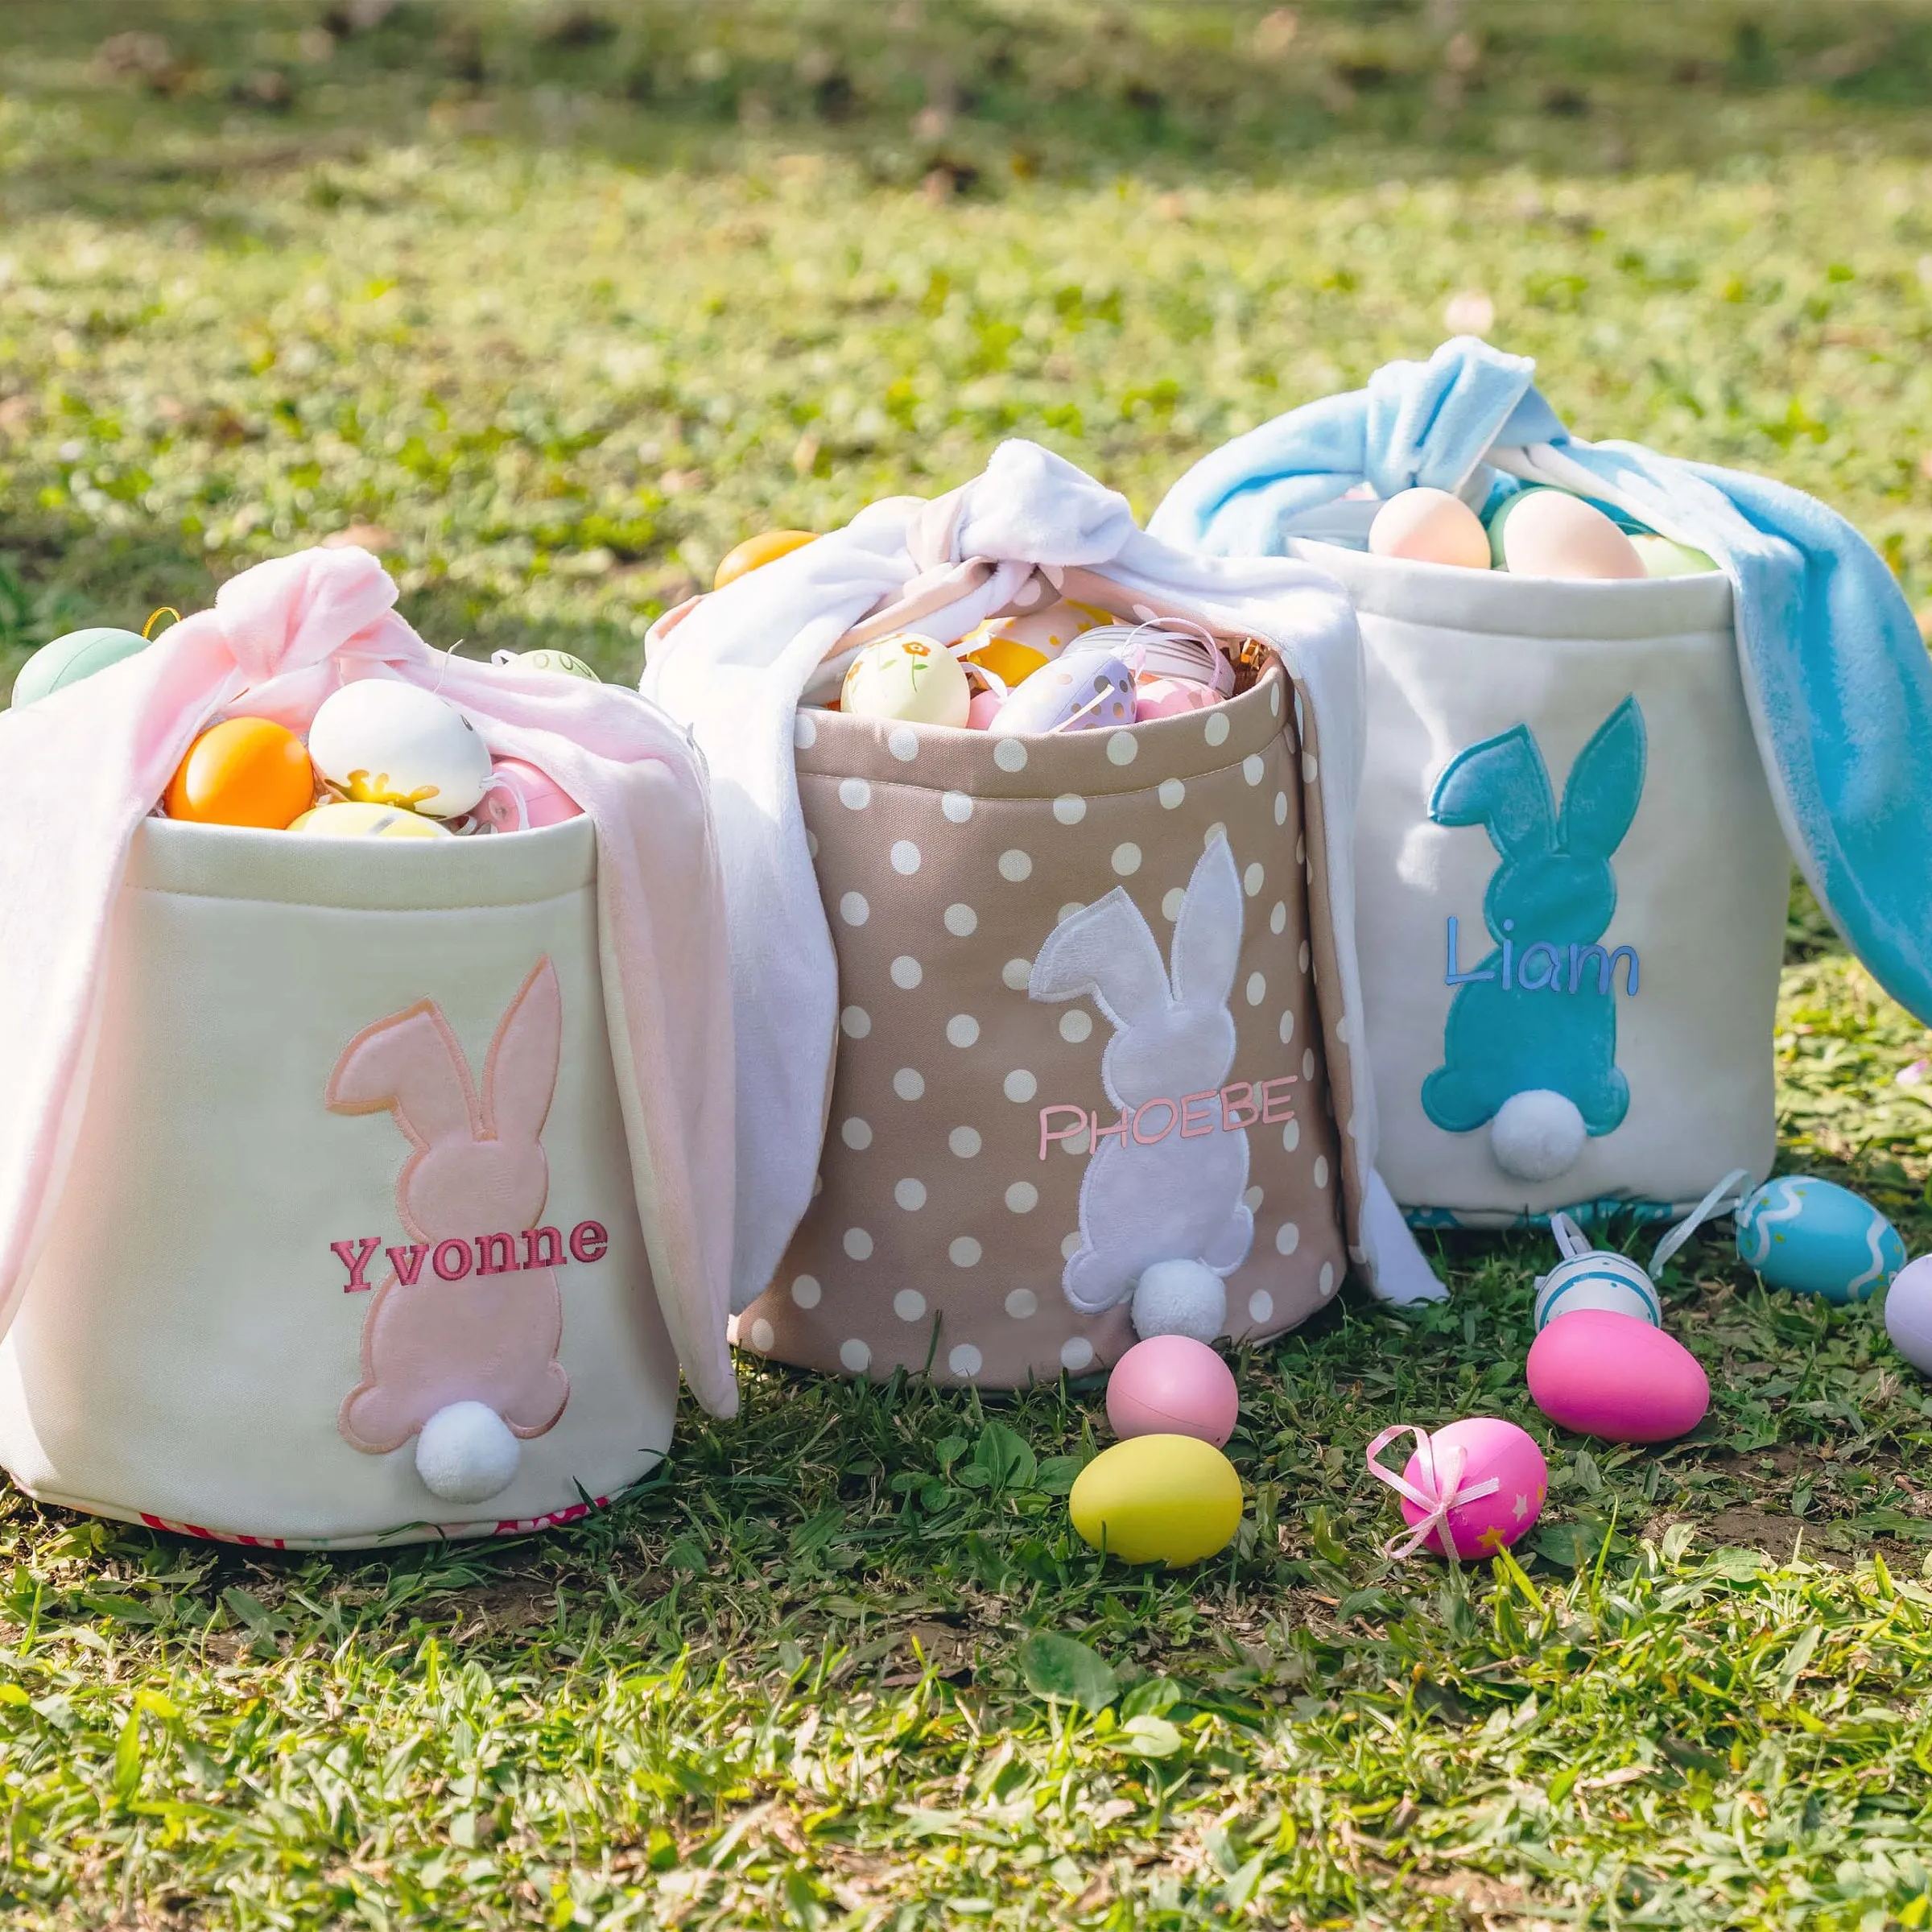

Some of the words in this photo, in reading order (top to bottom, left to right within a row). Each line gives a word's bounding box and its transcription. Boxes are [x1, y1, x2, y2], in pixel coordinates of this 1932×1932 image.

[1444, 915, 1639, 997] Liam
[1038, 1075, 1298, 1161] PHOEBE
[330, 1220, 608, 1294] Yvonne
